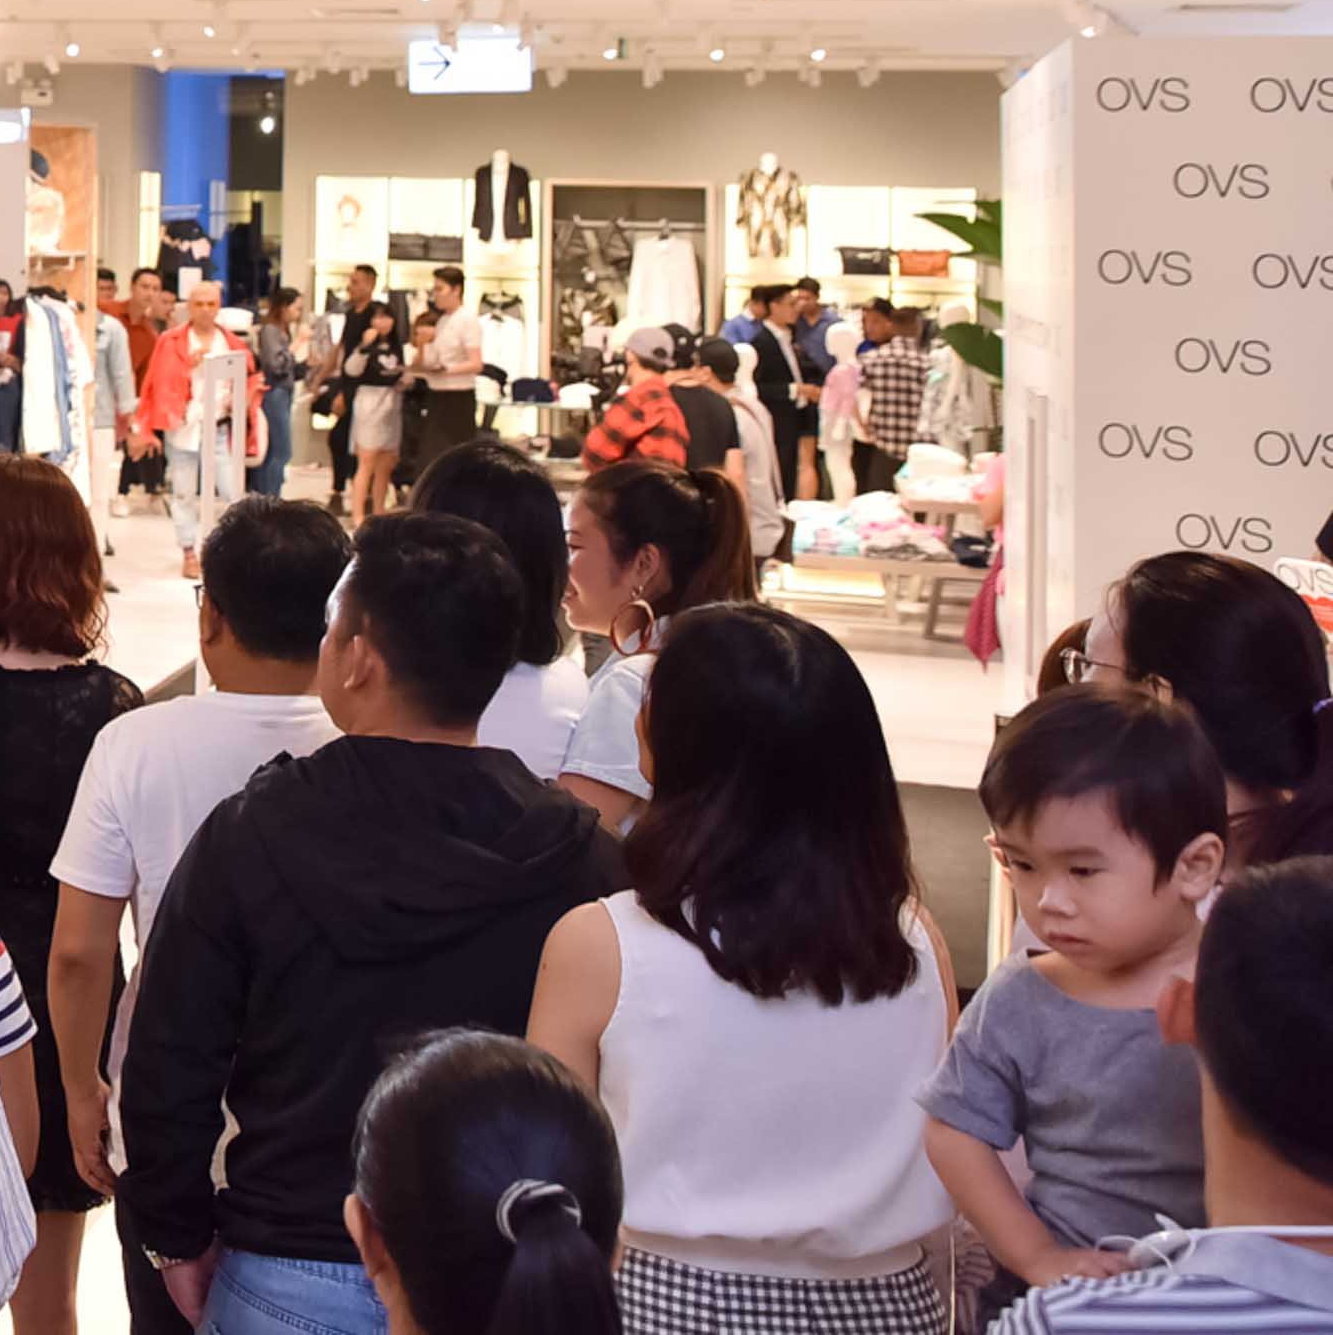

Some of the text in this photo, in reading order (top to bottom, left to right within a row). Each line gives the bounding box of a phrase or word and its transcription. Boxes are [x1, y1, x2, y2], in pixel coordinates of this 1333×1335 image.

[1096, 76, 1190, 113] OVS
[1173, 162, 1270, 200] OVS
[1097, 249, 1193, 287] OVS
[1174, 337, 1272, 377] OVS
[1098, 422, 1194, 462] OVS
[1175, 513, 1273, 554] OVS
